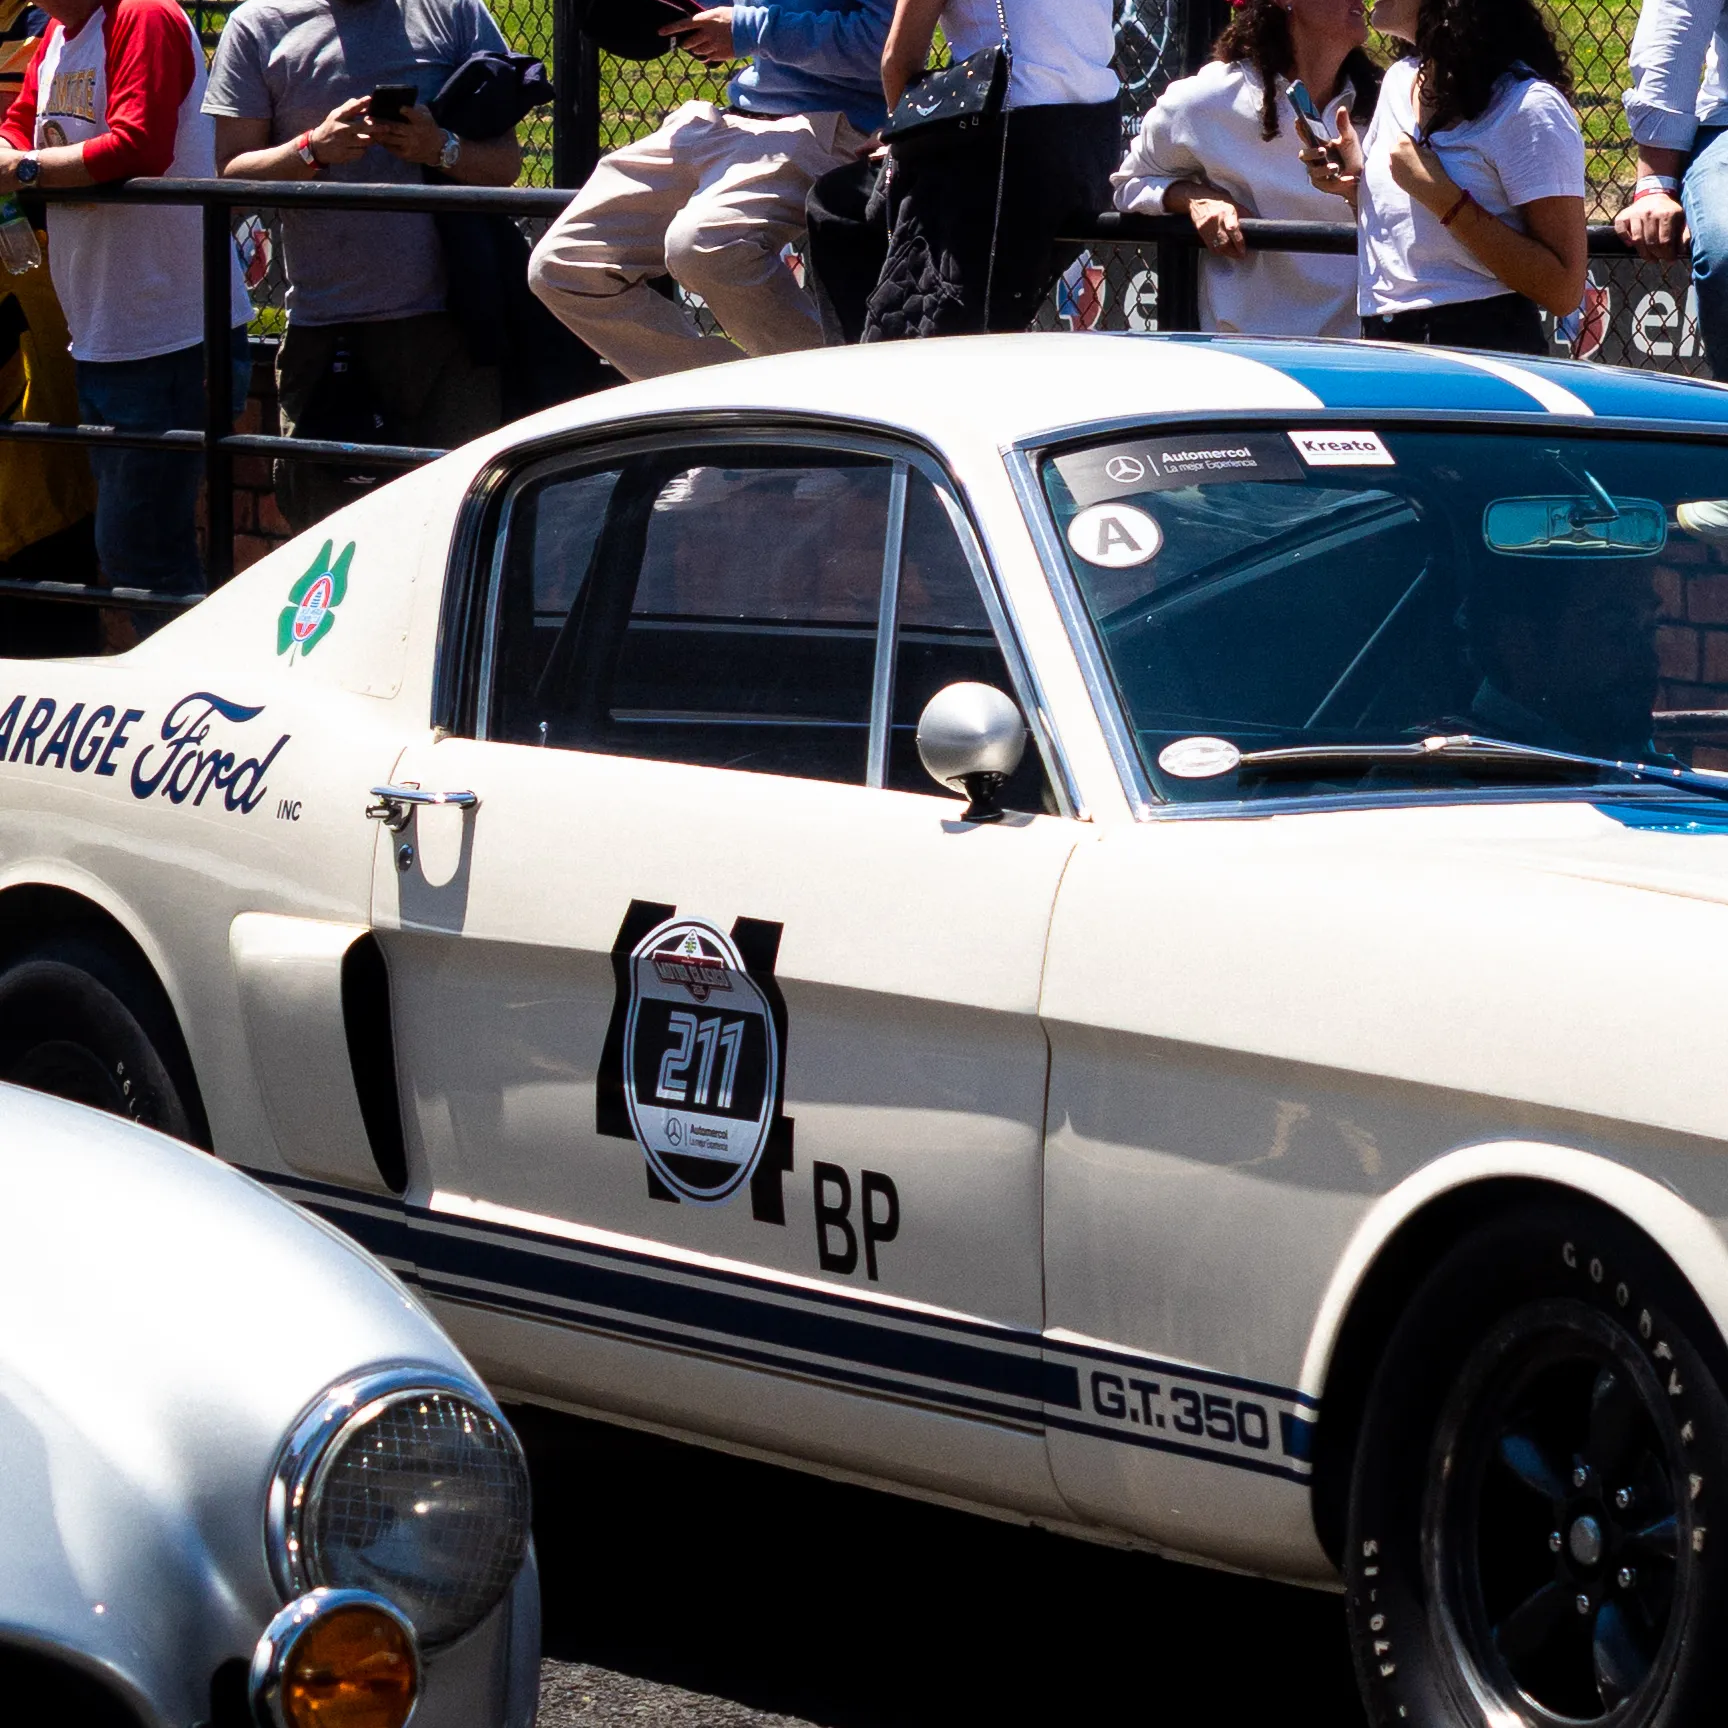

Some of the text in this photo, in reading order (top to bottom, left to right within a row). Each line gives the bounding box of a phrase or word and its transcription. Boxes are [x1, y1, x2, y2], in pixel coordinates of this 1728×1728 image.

[1632, 284, 1705, 357] el
[1162, 447, 1251, 463] Automercol
[1302, 439, 1377, 452] Kreato
[1097, 516, 1142, 556] A
[131, 692, 291, 814] Ford
[277, 799, 302, 821] INC
[656, 1010, 745, 1108] 211
[813, 1160, 900, 1281] BP
